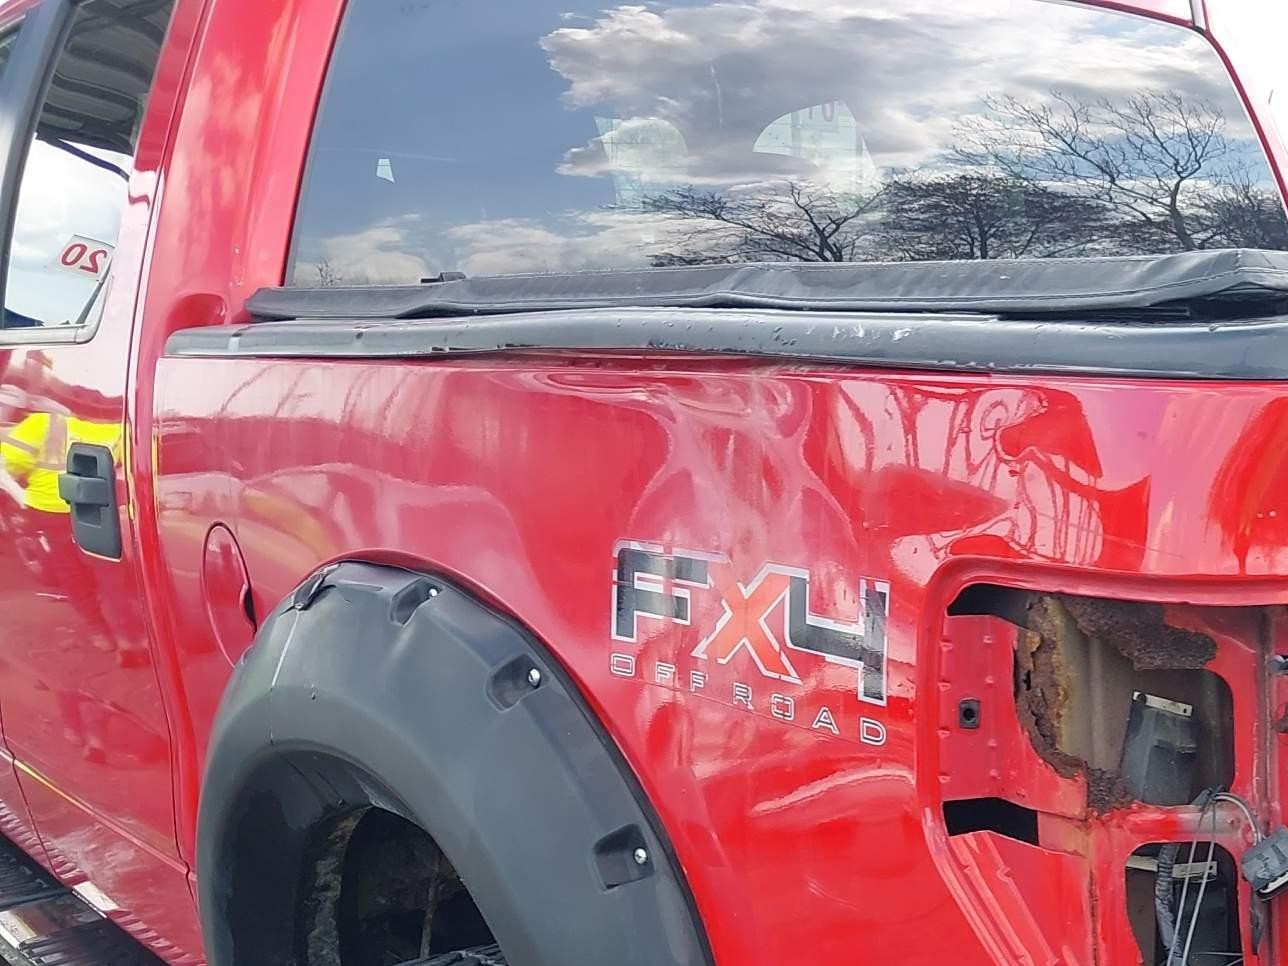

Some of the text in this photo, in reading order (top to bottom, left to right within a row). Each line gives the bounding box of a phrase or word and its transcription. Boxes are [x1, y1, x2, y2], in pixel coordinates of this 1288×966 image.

[611, 537, 891, 707] FX4
[611, 652, 887, 746] OFF ROAD
